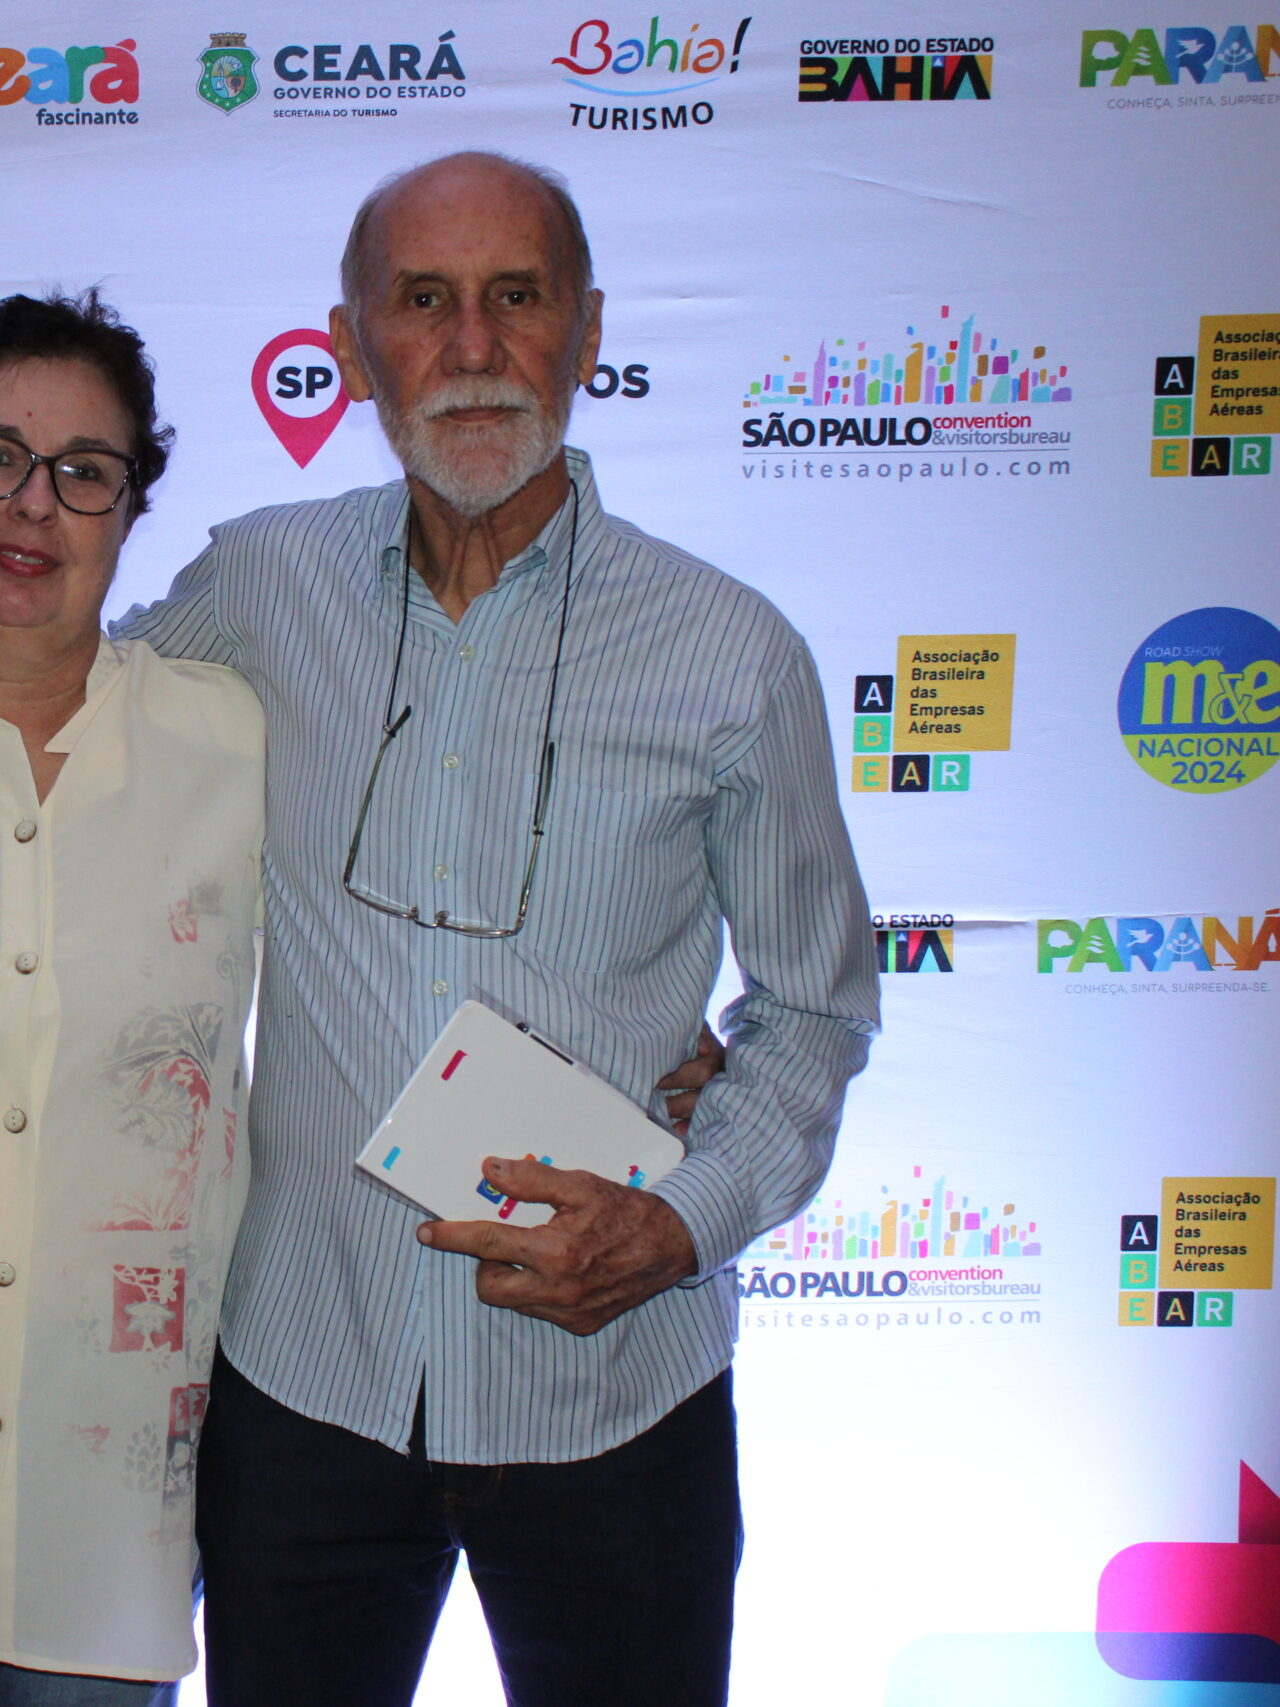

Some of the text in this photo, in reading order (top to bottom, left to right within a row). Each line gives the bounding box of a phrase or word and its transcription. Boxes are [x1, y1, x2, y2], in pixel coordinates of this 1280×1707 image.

[800, 38, 994, 54] GOVERNO DO ESTADO
[274, 29, 465, 81] CEARÁ
[274, 86, 465, 99] GOVERNO DO ESTADO
[36, 108, 139, 126] fascinante
[273, 109, 397, 118] SECRETARIA DO TURISMO
[569, 102, 714, 131] TURISMO
[1213, 349, 1280, 361] Brasileir
[1212, 368, 1239, 379] das
[275, 366, 333, 399] SP
[1210, 404, 1263, 416] Aéreas
[742, 412, 1031, 447] SÃO PAULO convention
[742, 455, 1071, 482] visitesaopaulo.com
[912, 650, 999, 665] Associação
[1145, 647, 1181, 657] ROAD
[912, 668, 985, 681] Brasileira
[910, 686, 937, 699] das
[910, 703, 984, 718] Empresas
[909, 720, 961, 734] Aéreas
[1138, 737, 1279, 758] NACIONAL
[1171, 761, 1246, 784] 2024
[872, 914, 954, 928] O ESTADO
[1176, 1191, 1261, 1207] Associação
[1175, 1209, 1247, 1222] Brasileira
[1175, 1226, 1200, 1238] das
[1174, 1243, 1247, 1257] Empresas
[1173, 1259, 1225, 1273] Aéreas
[800, 1271, 907, 1297] PAULO
[909, 1265, 1003, 1281] convention
[745, 1307, 1040, 1330] isitesaopaulo.com
